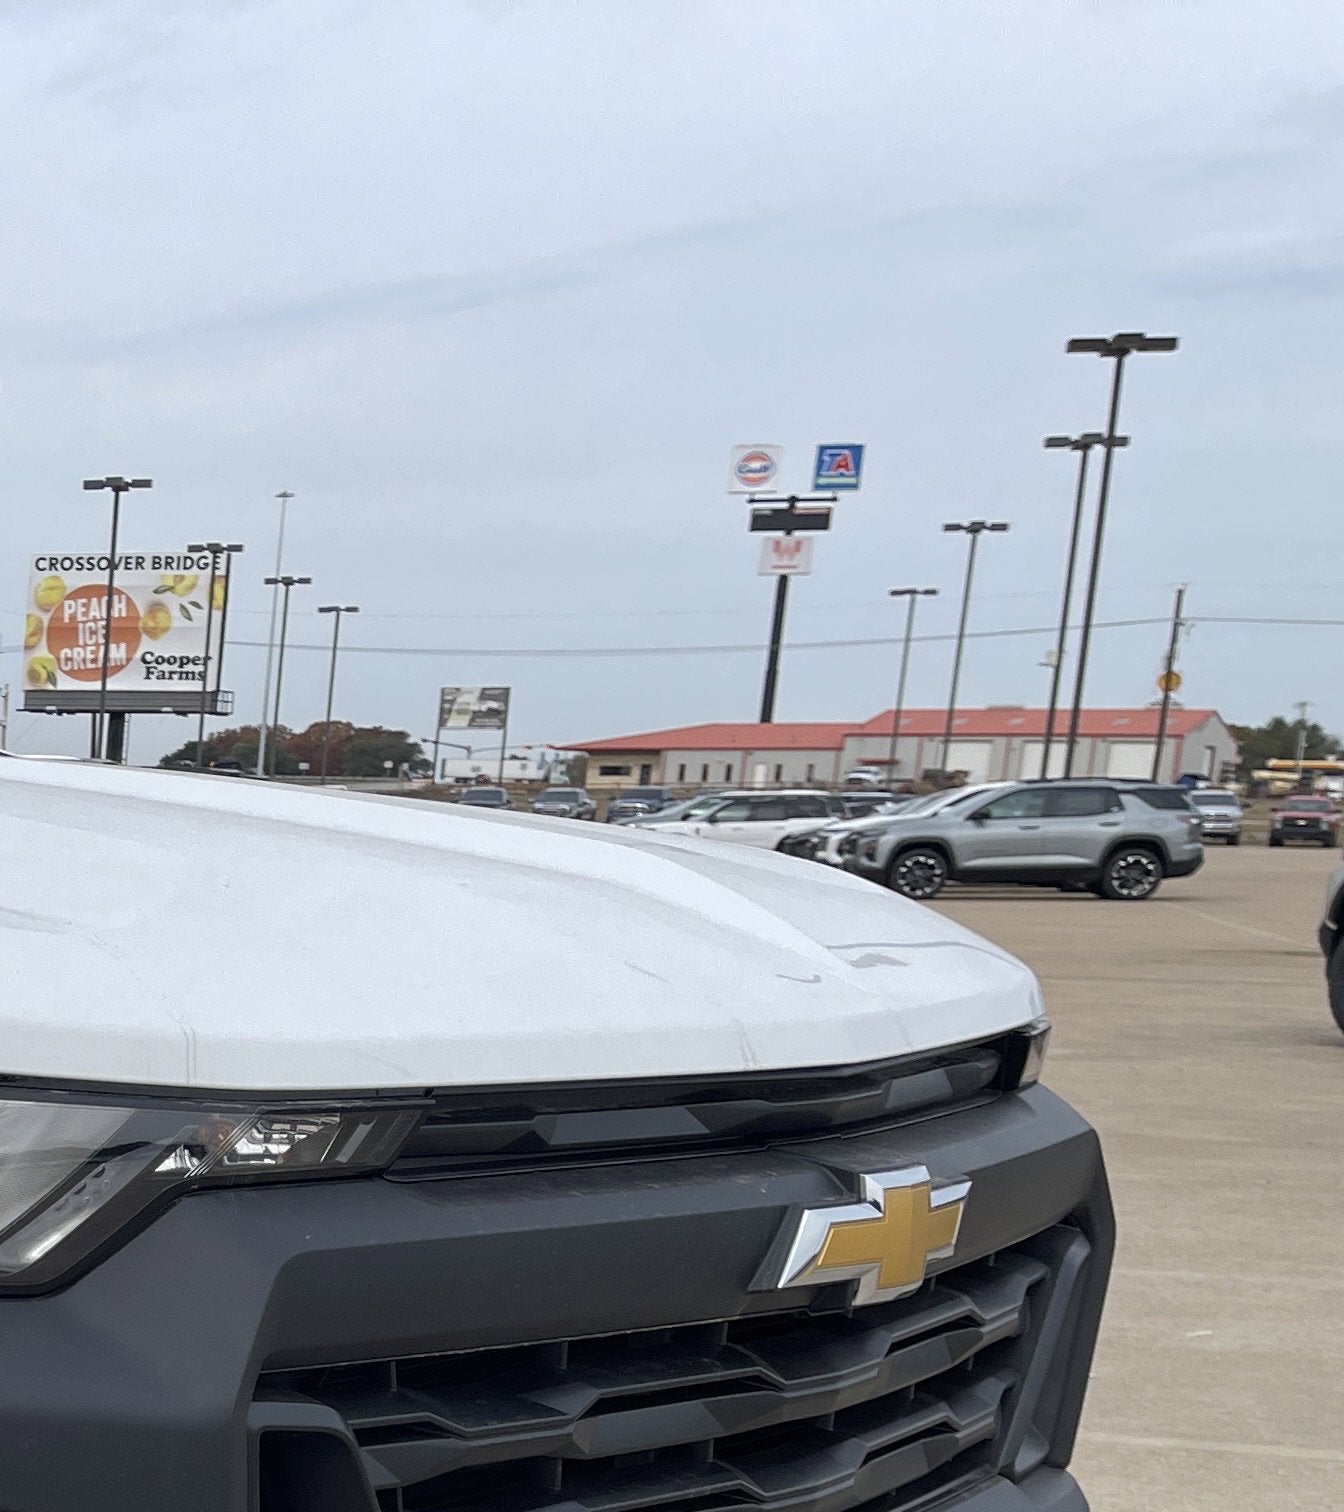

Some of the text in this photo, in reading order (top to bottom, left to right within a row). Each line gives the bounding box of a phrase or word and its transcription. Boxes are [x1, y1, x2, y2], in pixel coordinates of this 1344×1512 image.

[34, 554, 221, 572] CROSSOVER BRIDGE
[77, 620, 108, 646] ICE
[59, 642, 127, 672] CREAM
[140, 650, 213, 669] Cooper
[143, 665, 207, 682] Farms
